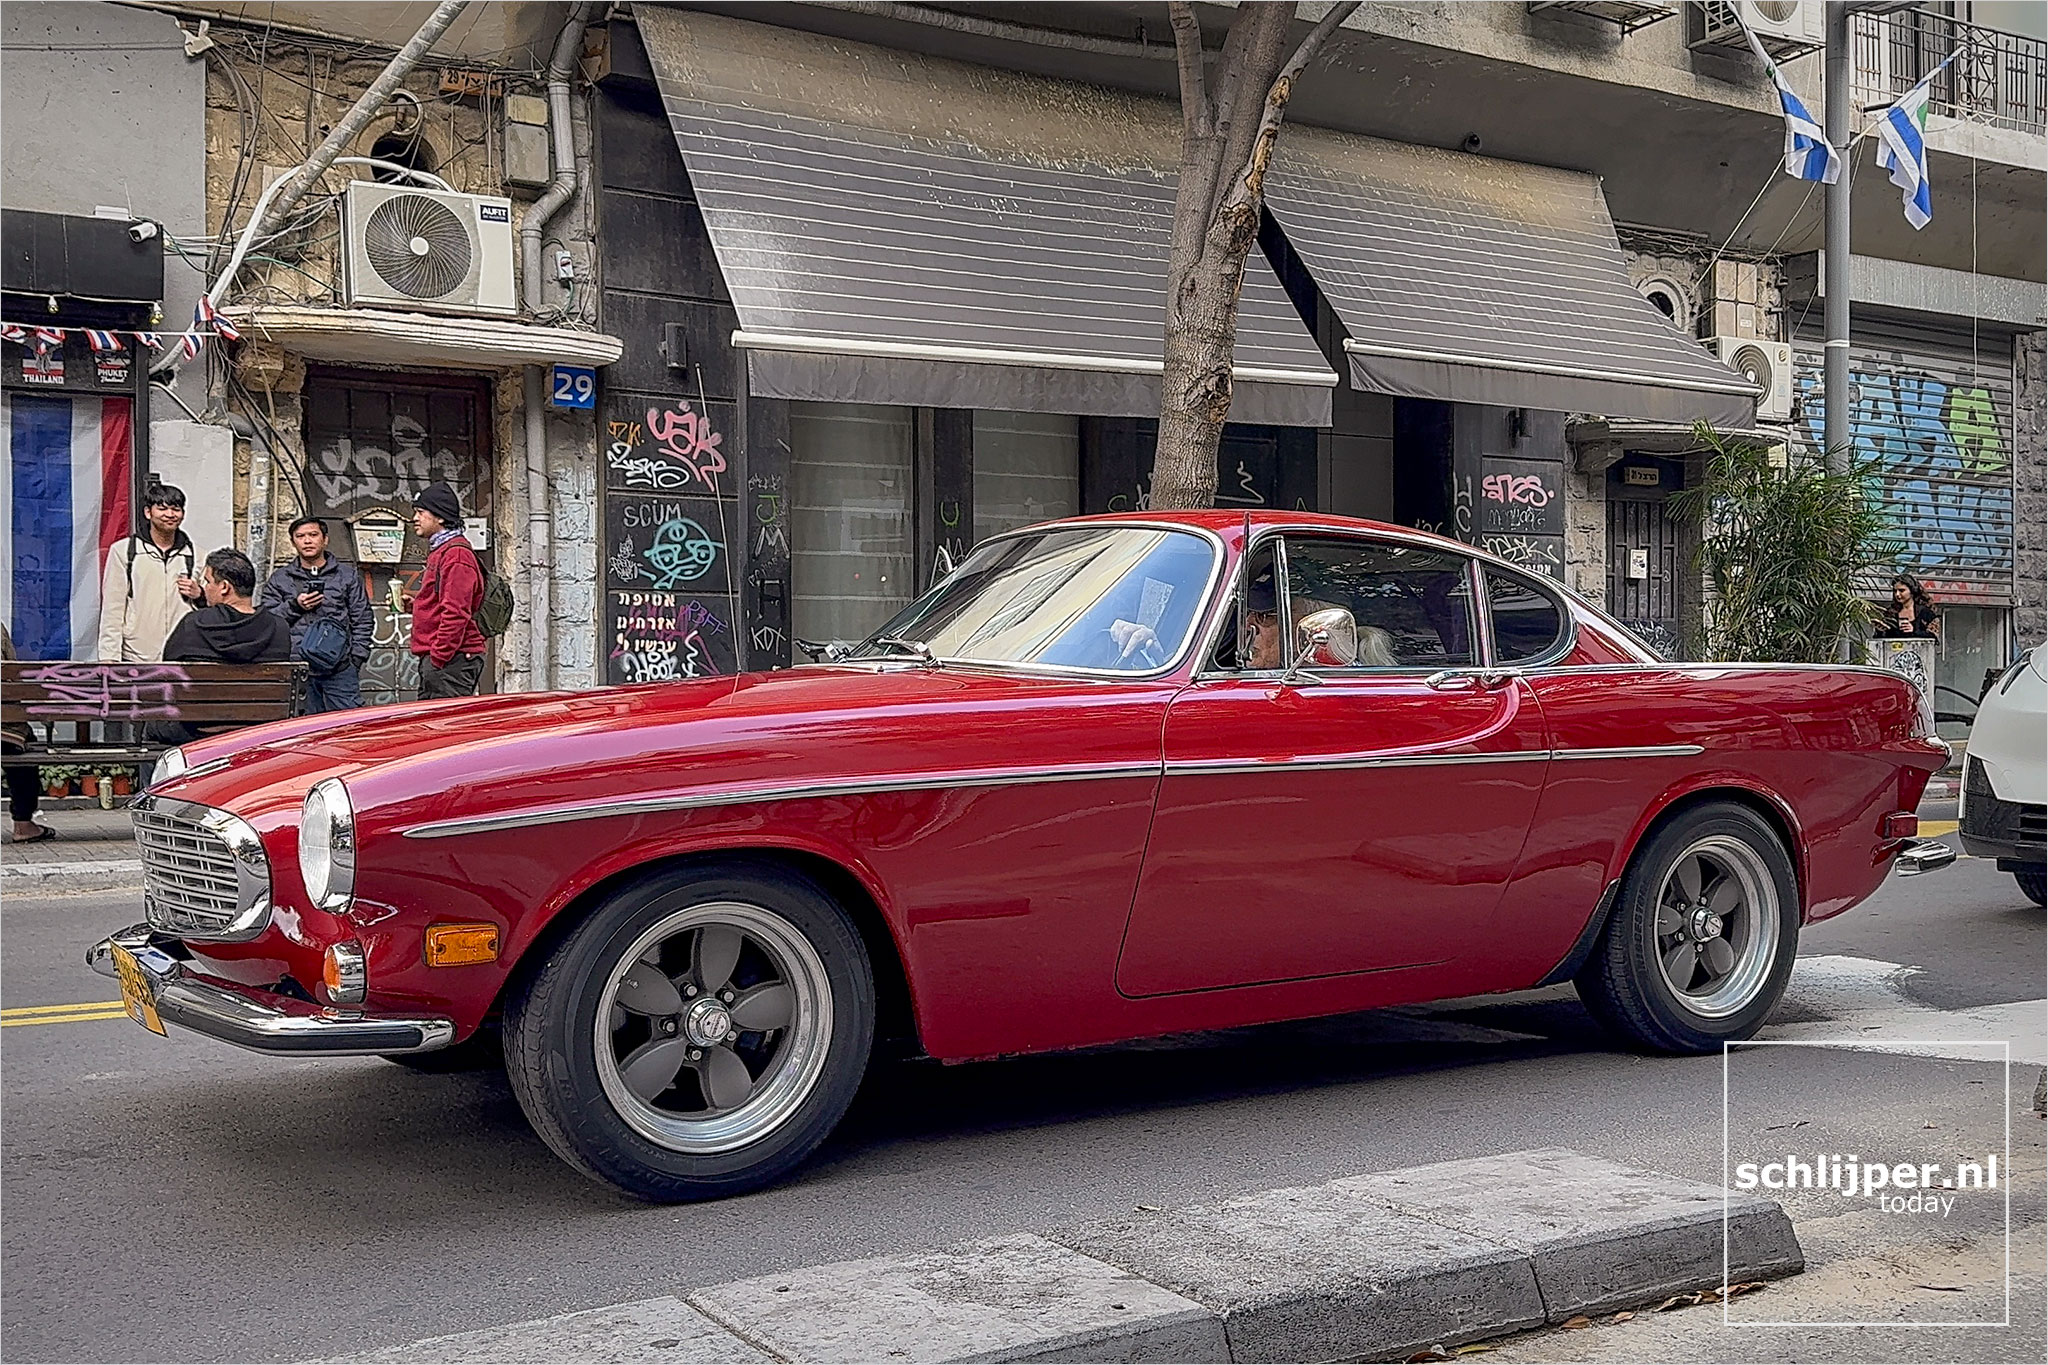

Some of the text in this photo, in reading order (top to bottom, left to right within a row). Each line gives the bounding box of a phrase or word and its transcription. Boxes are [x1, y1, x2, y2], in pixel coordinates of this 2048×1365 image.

[482, 207, 507, 216] AUFIT
[97, 369, 129, 377] PHUKET
[22, 374, 65, 385] THAILAND
[555, 372, 593, 403] 29
